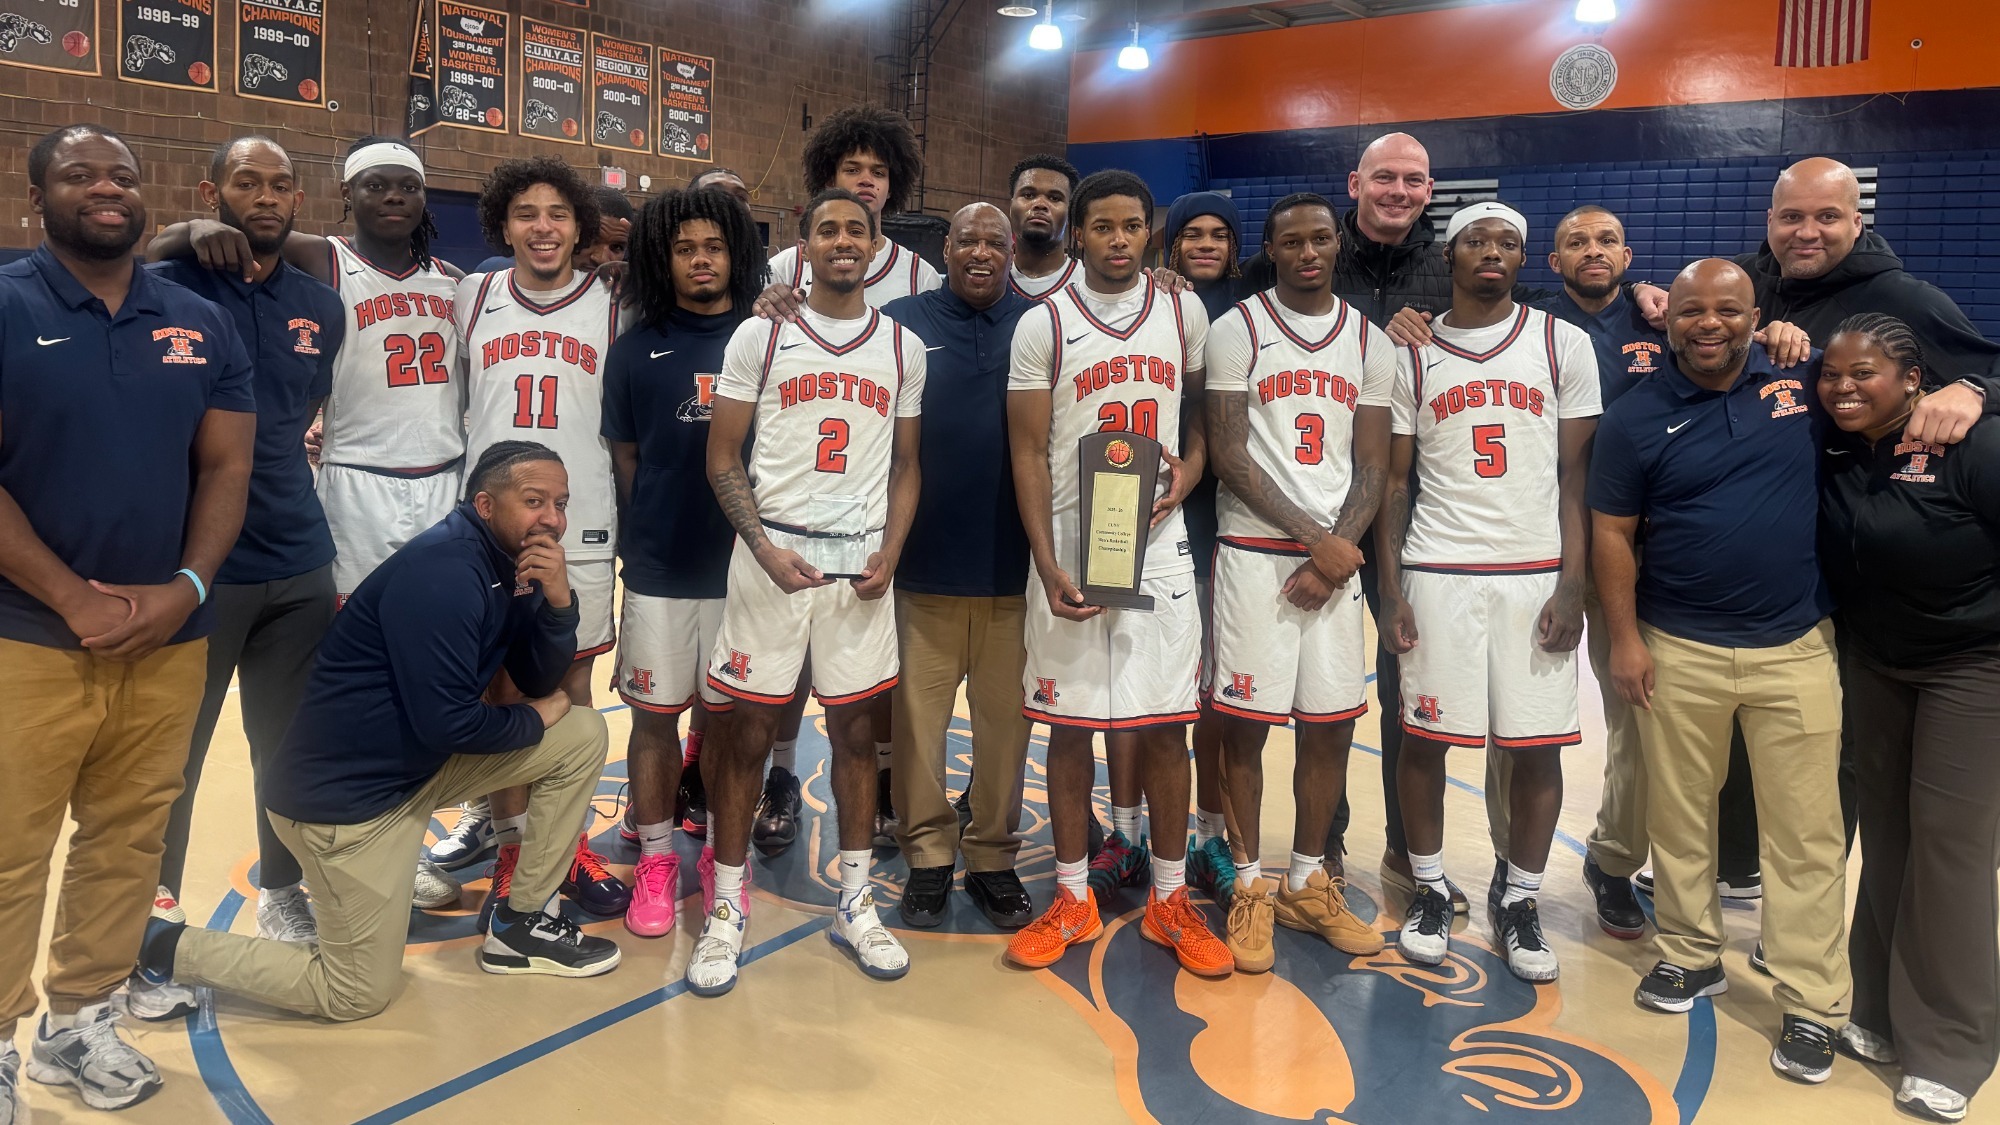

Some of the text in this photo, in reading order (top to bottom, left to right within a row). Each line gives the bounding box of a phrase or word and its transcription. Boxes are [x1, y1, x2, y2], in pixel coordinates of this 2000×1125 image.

[137, 5, 199, 29] 1998-99
[242, 4, 321, 36] CHAMPIONS
[442, 4, 504, 28] NATIONAL
[253, 26, 310, 48] 1999-00
[441, 25, 504, 48] TOURNAMENT
[525, 32, 582, 51] BASKETBALL
[531, 24, 577, 41] WOMEN'S
[466, 42, 494, 55] PLACE
[524, 44, 583, 64] C.U.N.Y.A.C.
[595, 46, 648, 65] BASKETBALL
[602, 39, 643, 55] WOMEN'S
[441, 57, 503, 76] BASKETBALL
[448, 49, 497, 66] WOMEN'S
[596, 58, 648, 77] REGION XV
[662, 51, 710, 72] NATIONAL
[450, 70, 495, 89] 1999-00
[525, 57, 582, 84] CHAMPIONS
[662, 70, 710, 88] TOURNAMENT
[533, 76, 574, 94] 2000-01
[595, 71, 648, 96] CHAMPIONS
[681, 84, 703, 95] PLACE
[603, 89, 641, 106] 2000-01
[662, 97, 710, 113] BASKETBALL
[667, 90, 706, 104] WOMEN'S
[455, 107, 486, 123] 28-5
[669, 108, 704, 125] 2000-01
[674, 142, 697, 155] 25-4
[354, 292, 455, 331] HOSTOS
[482, 330, 598, 375] HOSTOS
[1621, 341, 1662, 355] HOSTOS
[384, 331, 449, 388] 22
[1073, 354, 1176, 403] HOSTOS
[513, 373, 558, 429] 11
[778, 371, 891, 418] HOSTOS
[1257, 369, 1359, 413] HOSTOS
[1428, 379, 1545, 425] HOSTOS
[814, 417, 850, 474] 2
[1294, 412, 1324, 465] 3
[1471, 423, 1509, 478] 5
